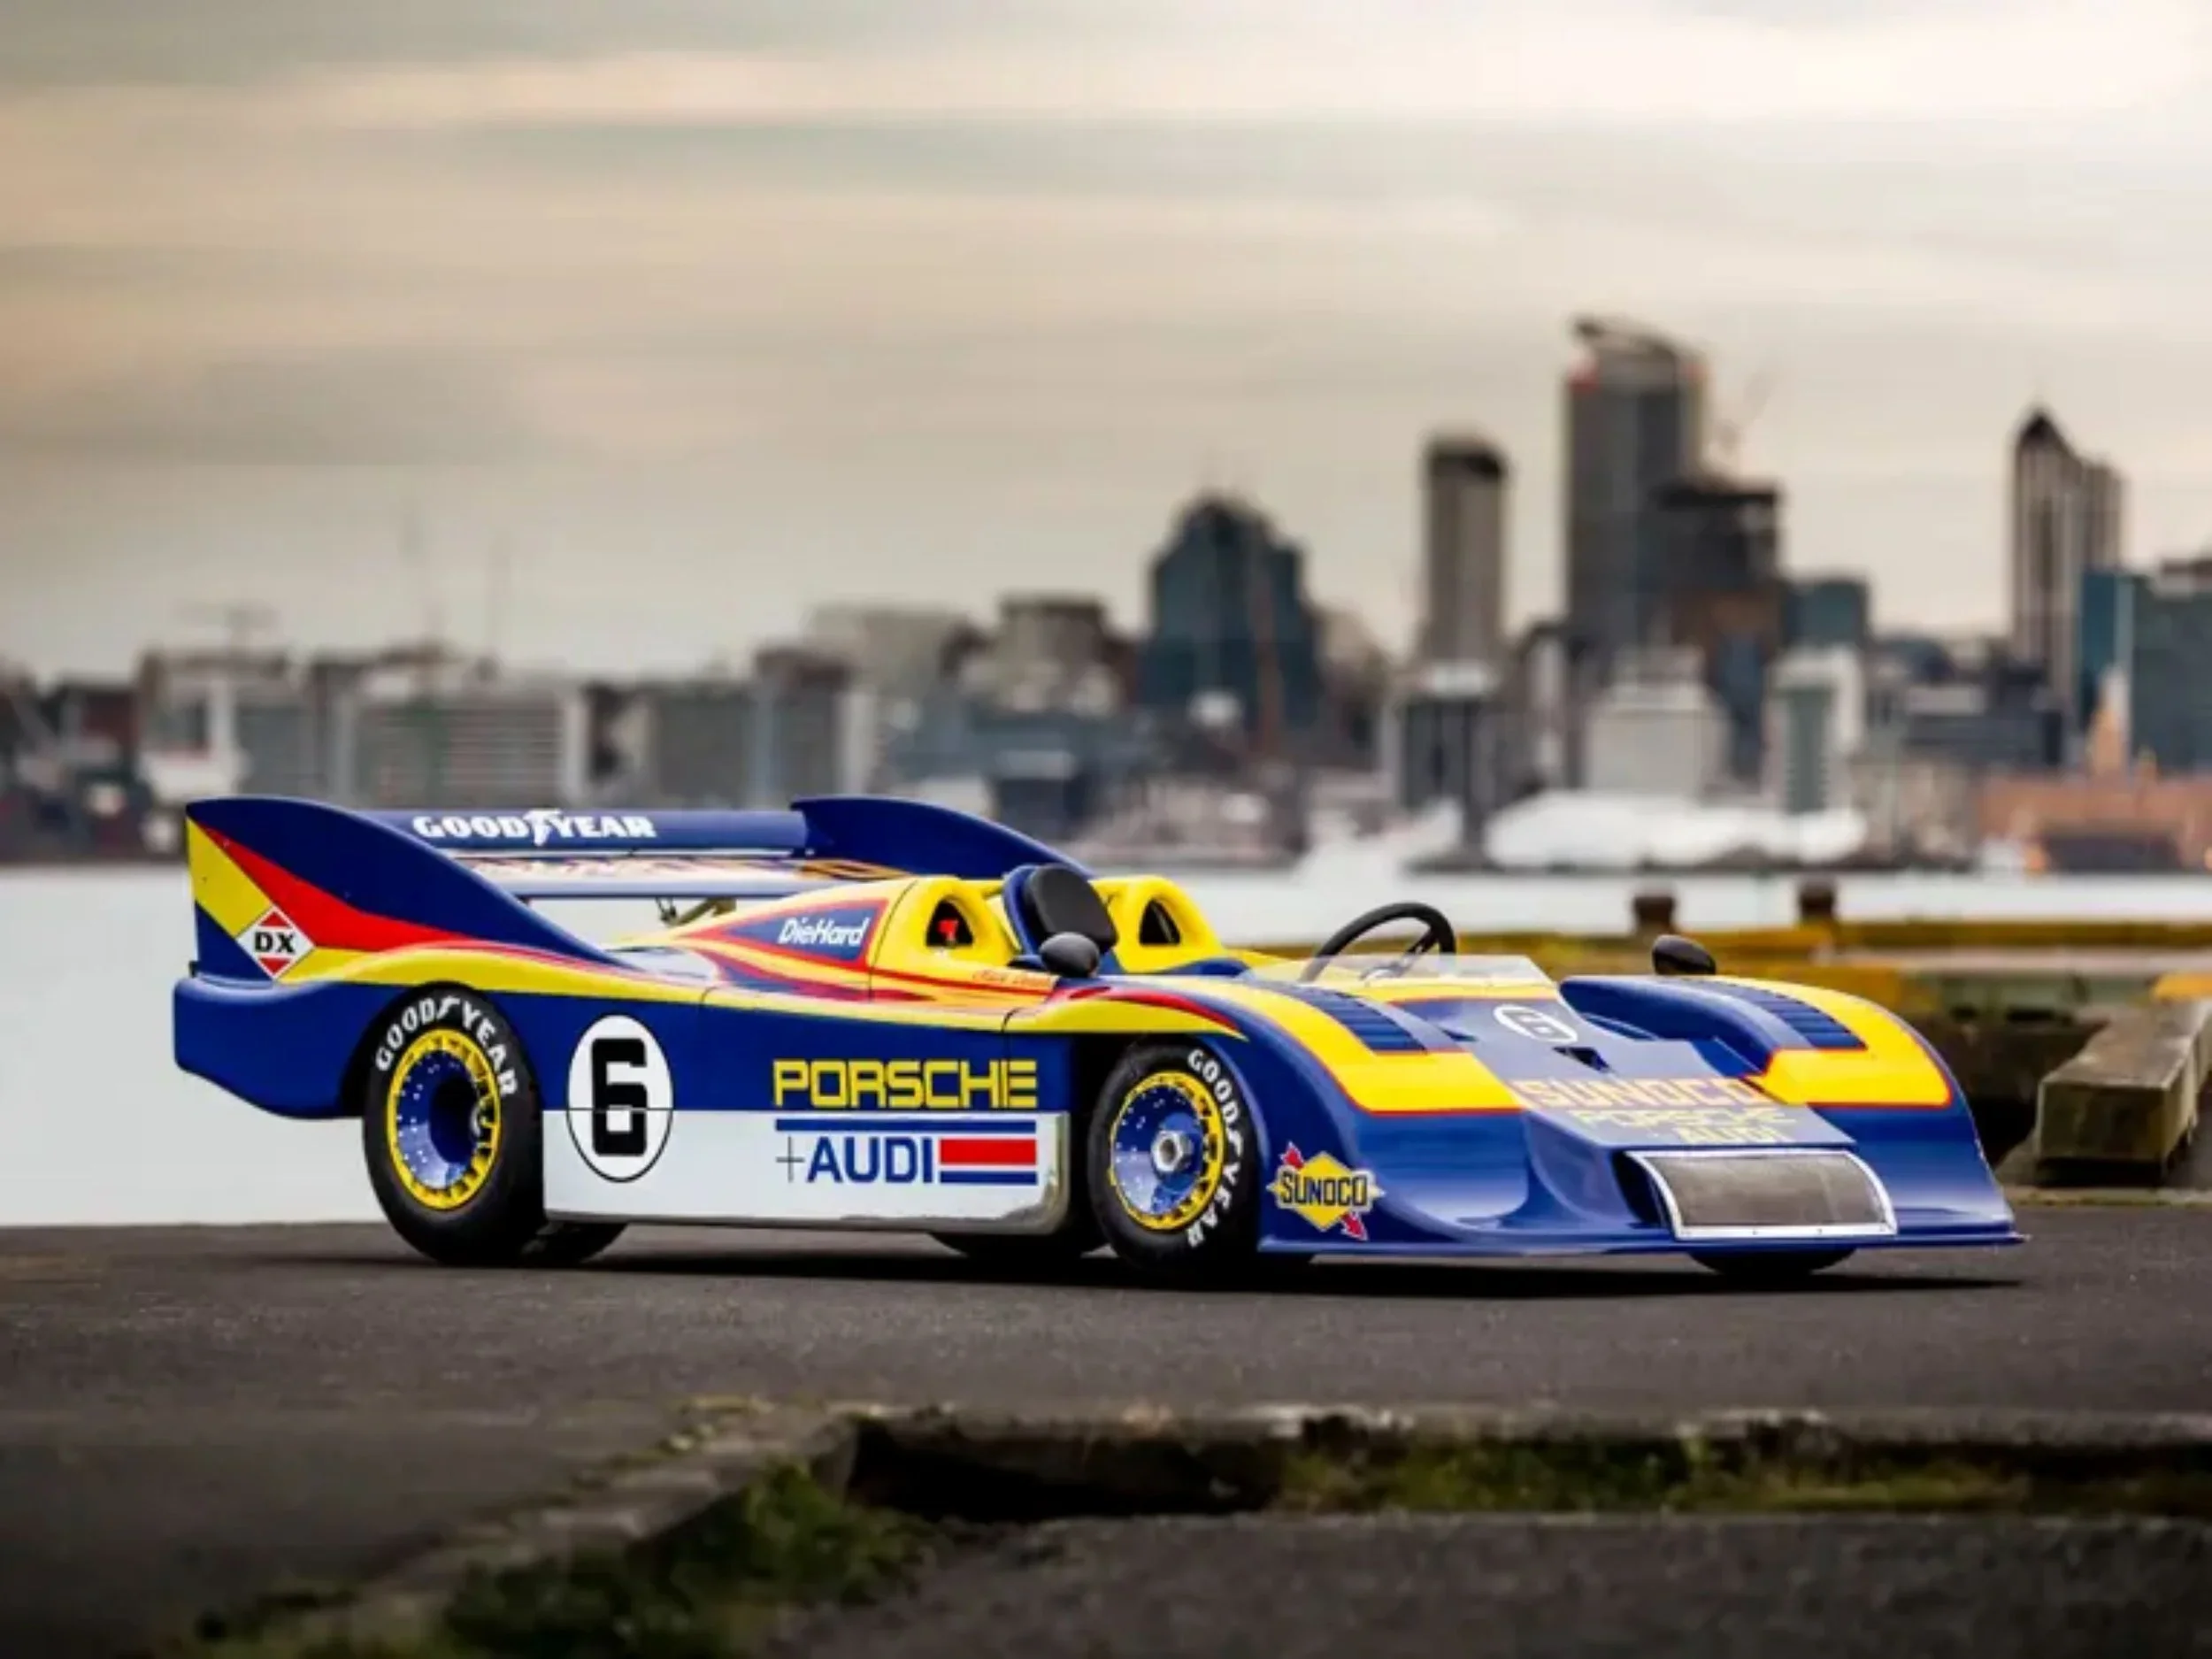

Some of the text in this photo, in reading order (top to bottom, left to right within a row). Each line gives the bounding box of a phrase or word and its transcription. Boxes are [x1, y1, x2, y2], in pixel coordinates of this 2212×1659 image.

[413, 809, 657, 846] GOODYEAR
[255, 932, 295, 953] DX
[779, 917, 871, 946] DieHard
[375, 996, 518, 1096] GOODYEAR
[590, 1038, 648, 1156] 6
[773, 1060, 1038, 1109] PORSCHE
[1508, 1077, 1786, 1107] SUNOCO
[1187, 1049, 1243, 1248] GOODYEAR
[1281, 1171, 1368, 1208] SUNOCO
